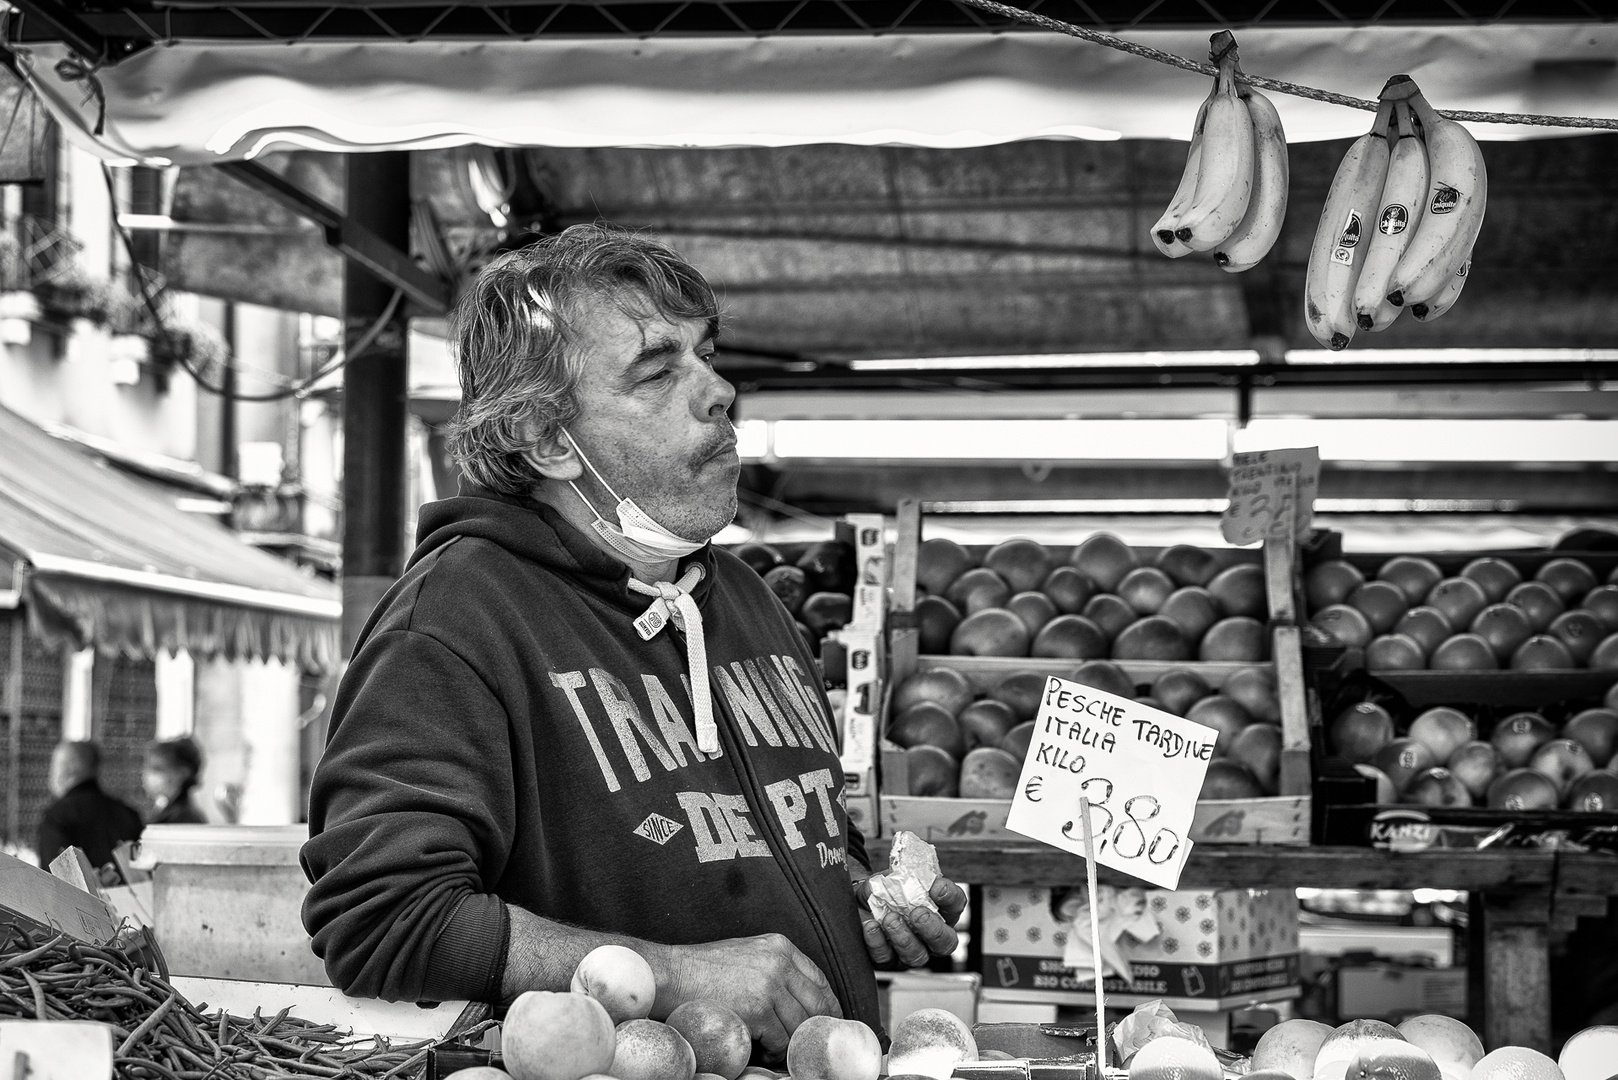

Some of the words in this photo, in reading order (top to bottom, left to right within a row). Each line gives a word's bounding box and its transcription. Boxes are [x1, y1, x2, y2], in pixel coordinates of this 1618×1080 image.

[1045, 716, 1116, 753] ITALIA
[1046, 678, 1126, 726] PESCHE
[1132, 719, 1214, 760] TARDIVE
[1036, 742, 1086, 774] KILO
[642, 817, 675, 841] SINCE
[1025, 776, 1043, 802] €
[1061, 778, 1179, 865] 3,80
